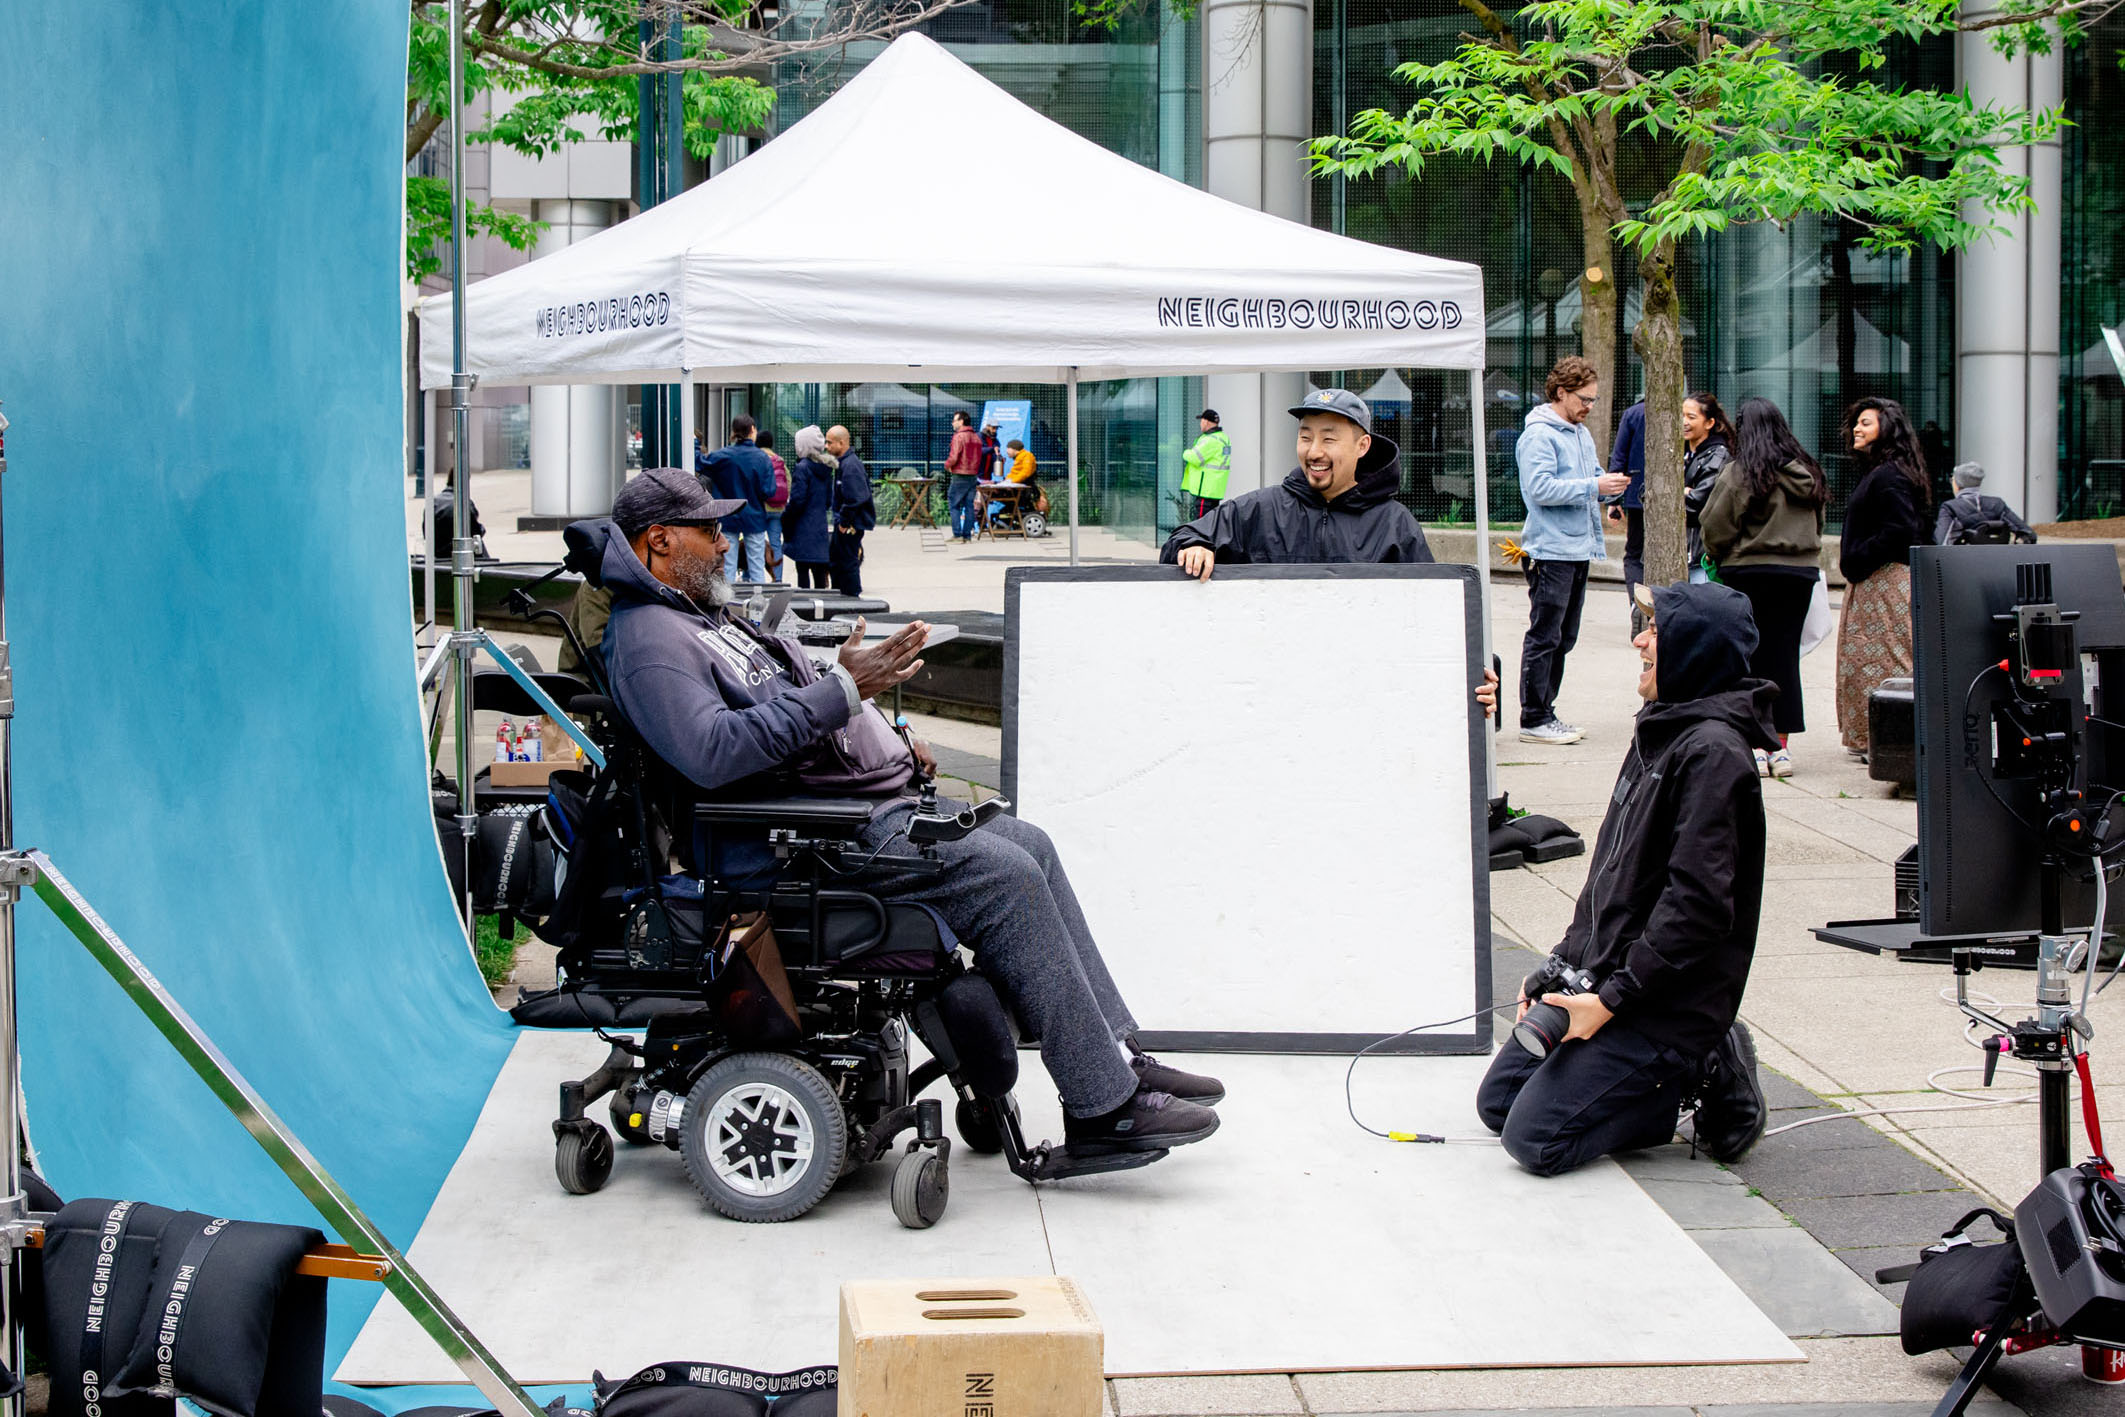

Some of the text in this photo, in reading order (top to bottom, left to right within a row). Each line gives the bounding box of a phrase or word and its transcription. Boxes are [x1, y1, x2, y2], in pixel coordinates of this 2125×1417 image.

[537, 291, 669, 339] NEIGHBOURHOOD
[1158, 297, 1463, 330] NEIGHBOURHOOD
[830, 1058, 860, 1068] edge
[688, 1366, 838, 1392] NEIGHBOURHOOD
